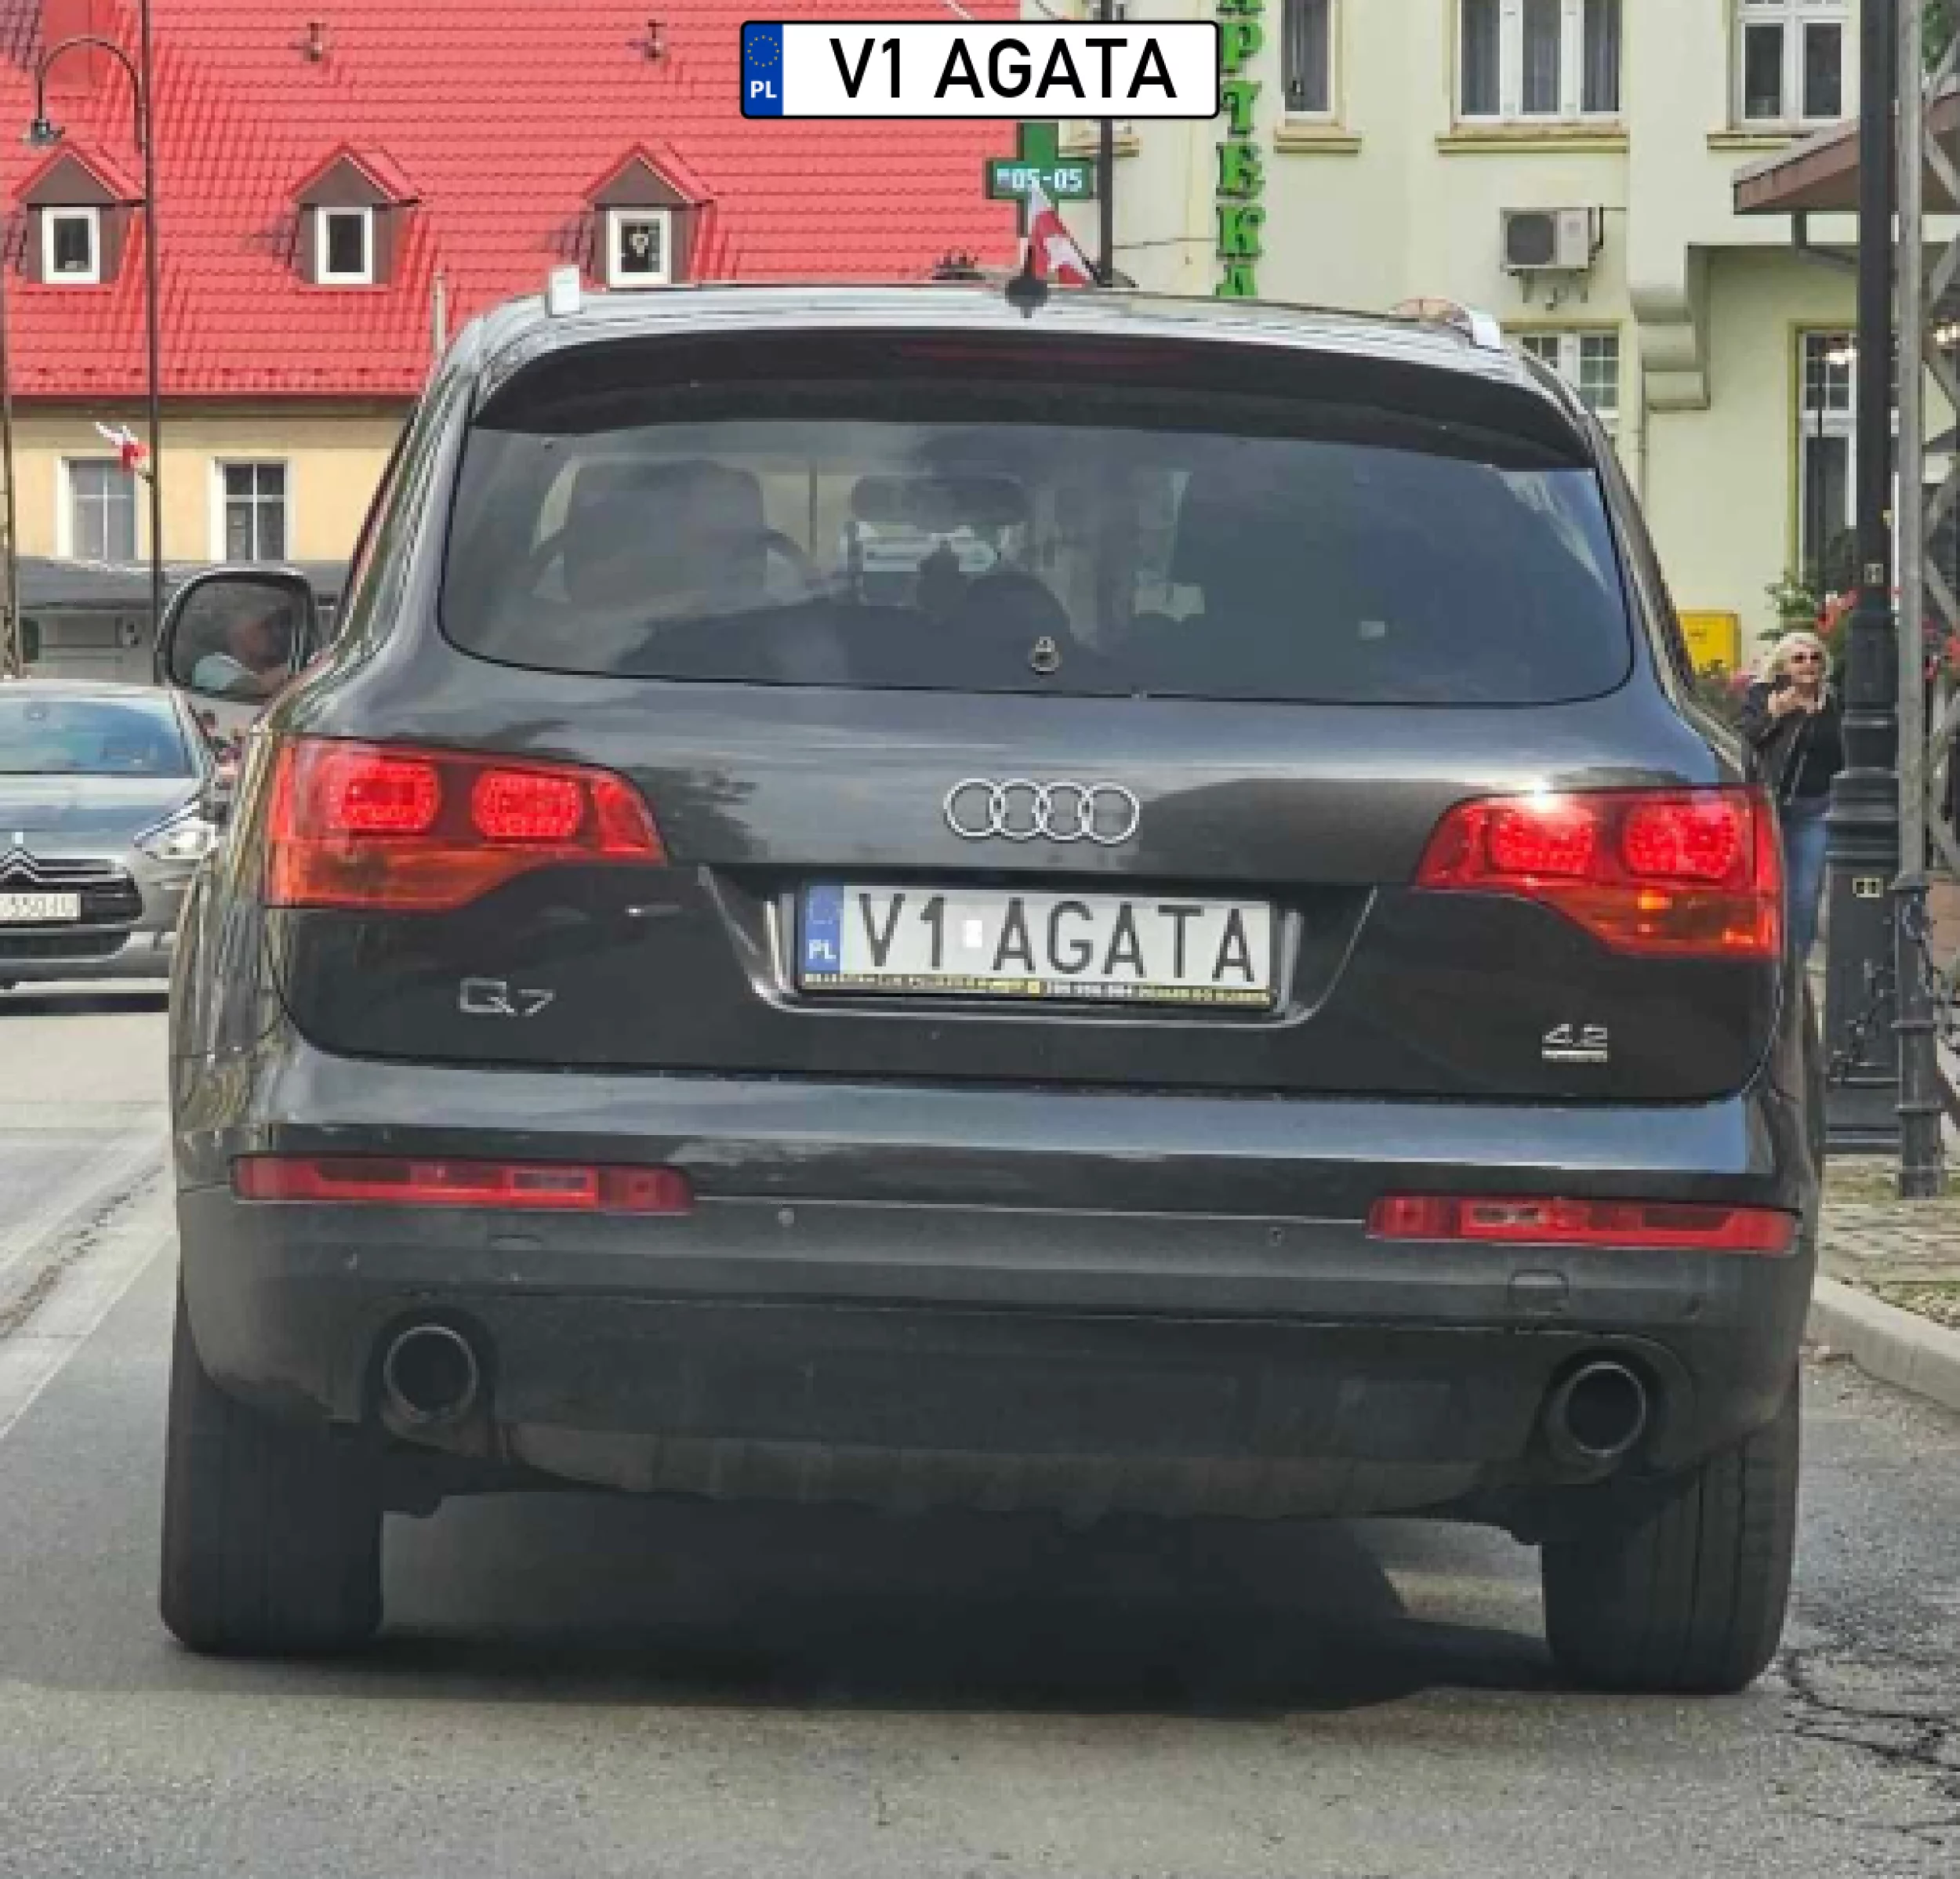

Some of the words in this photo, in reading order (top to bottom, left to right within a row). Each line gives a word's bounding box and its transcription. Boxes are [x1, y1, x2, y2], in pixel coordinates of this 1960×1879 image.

[1215, 0, 1265, 299] PTEKA
[808, 940, 837, 960] PL
[859, 893, 945, 967] V1
[992, 897, 1254, 981] AGATA
[459, 977, 554, 1017] Q7
